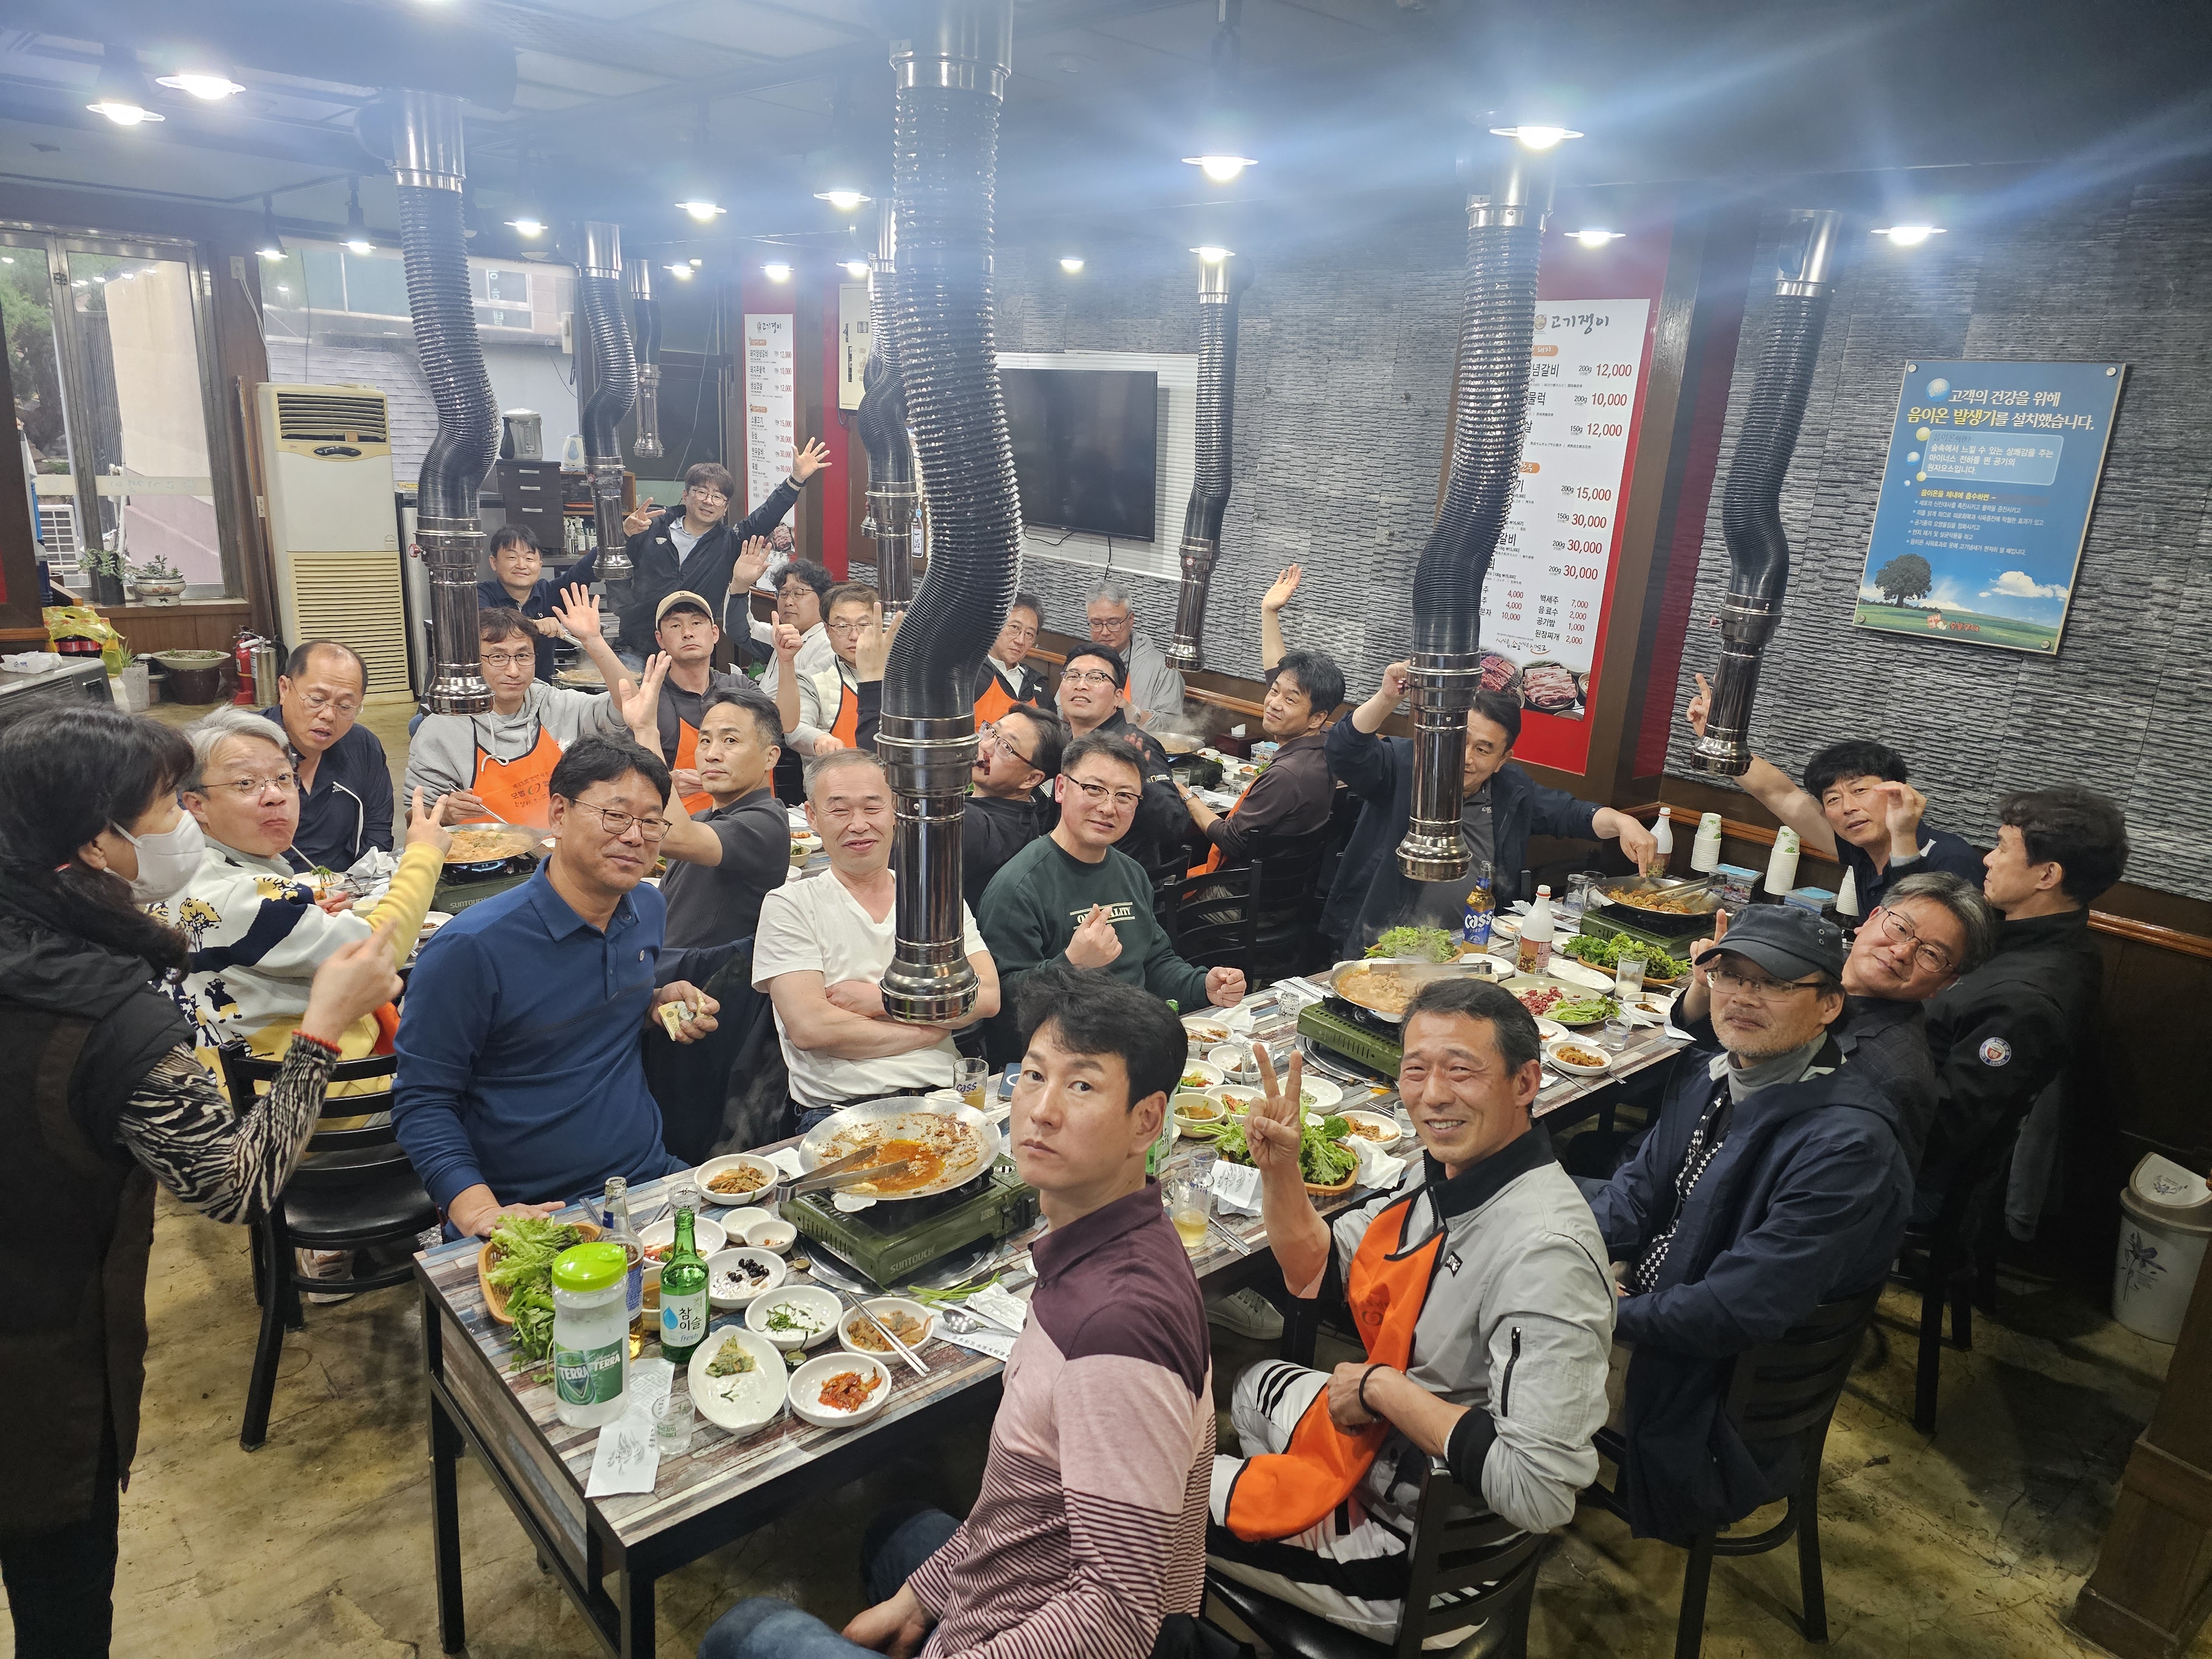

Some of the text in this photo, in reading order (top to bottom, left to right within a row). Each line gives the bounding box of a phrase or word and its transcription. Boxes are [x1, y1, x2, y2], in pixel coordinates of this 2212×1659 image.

[763, 322, 781, 333] 고기쟁이
[1551, 314, 1609, 334] 고기쟁이
[1532, 363, 1559, 377] 념갈비
[1597, 364, 1632, 378] 12,000
[1528, 392, 1546, 405] 물럭
[1592, 393, 1627, 407] 10,000
[1949, 389, 2061, 407] 고객의 건강을 위해
[1907, 407, 2094, 430] 음이온 발생기를 설치했습니다.
[1588, 423, 1622, 437] 12,000
[1931, 444, 1959, 453] 숲속에서
[1989, 447, 2004, 455] 있는
[2006, 447, 2036, 457] 상쾌감을
[2038, 449, 2054, 458] 주는
[1929, 454, 1957, 462] 마이너스
[1959, 456, 1980, 465] 전하를
[1993, 457, 2016, 467] 공기의
[1577, 487, 1611, 501] 15,000
[1921, 489, 1944, 498] 음이온을
[1946, 491, 1964, 499] 체내에
[1557, 513, 1606, 528] 150g 30,000
[1499, 533, 1602, 554] 갈비 200g 30,000
[1548, 565, 1598, 580] 200g 30,000
[1507, 590, 1524, 598] 4,000
[1540, 594, 1588, 608] 백세주 7,000
[1506, 601, 1522, 609] 4,000
[1479, 607, 1520, 620] 분자 10,000
[1538, 606, 1587, 620] 음료수 2,000
[1536, 617, 1584, 632] 공기밥 1,000
[1535, 629, 1560, 641] 된장찌개
[1566, 635, 1583, 645] 2,000
[890, 1245, 936, 1275] SUNTOUCH
[680, 1333, 698, 1342] fresh
[594, 1354, 621, 1371] TERRA
[559, 1366, 590, 1380] TERRA
